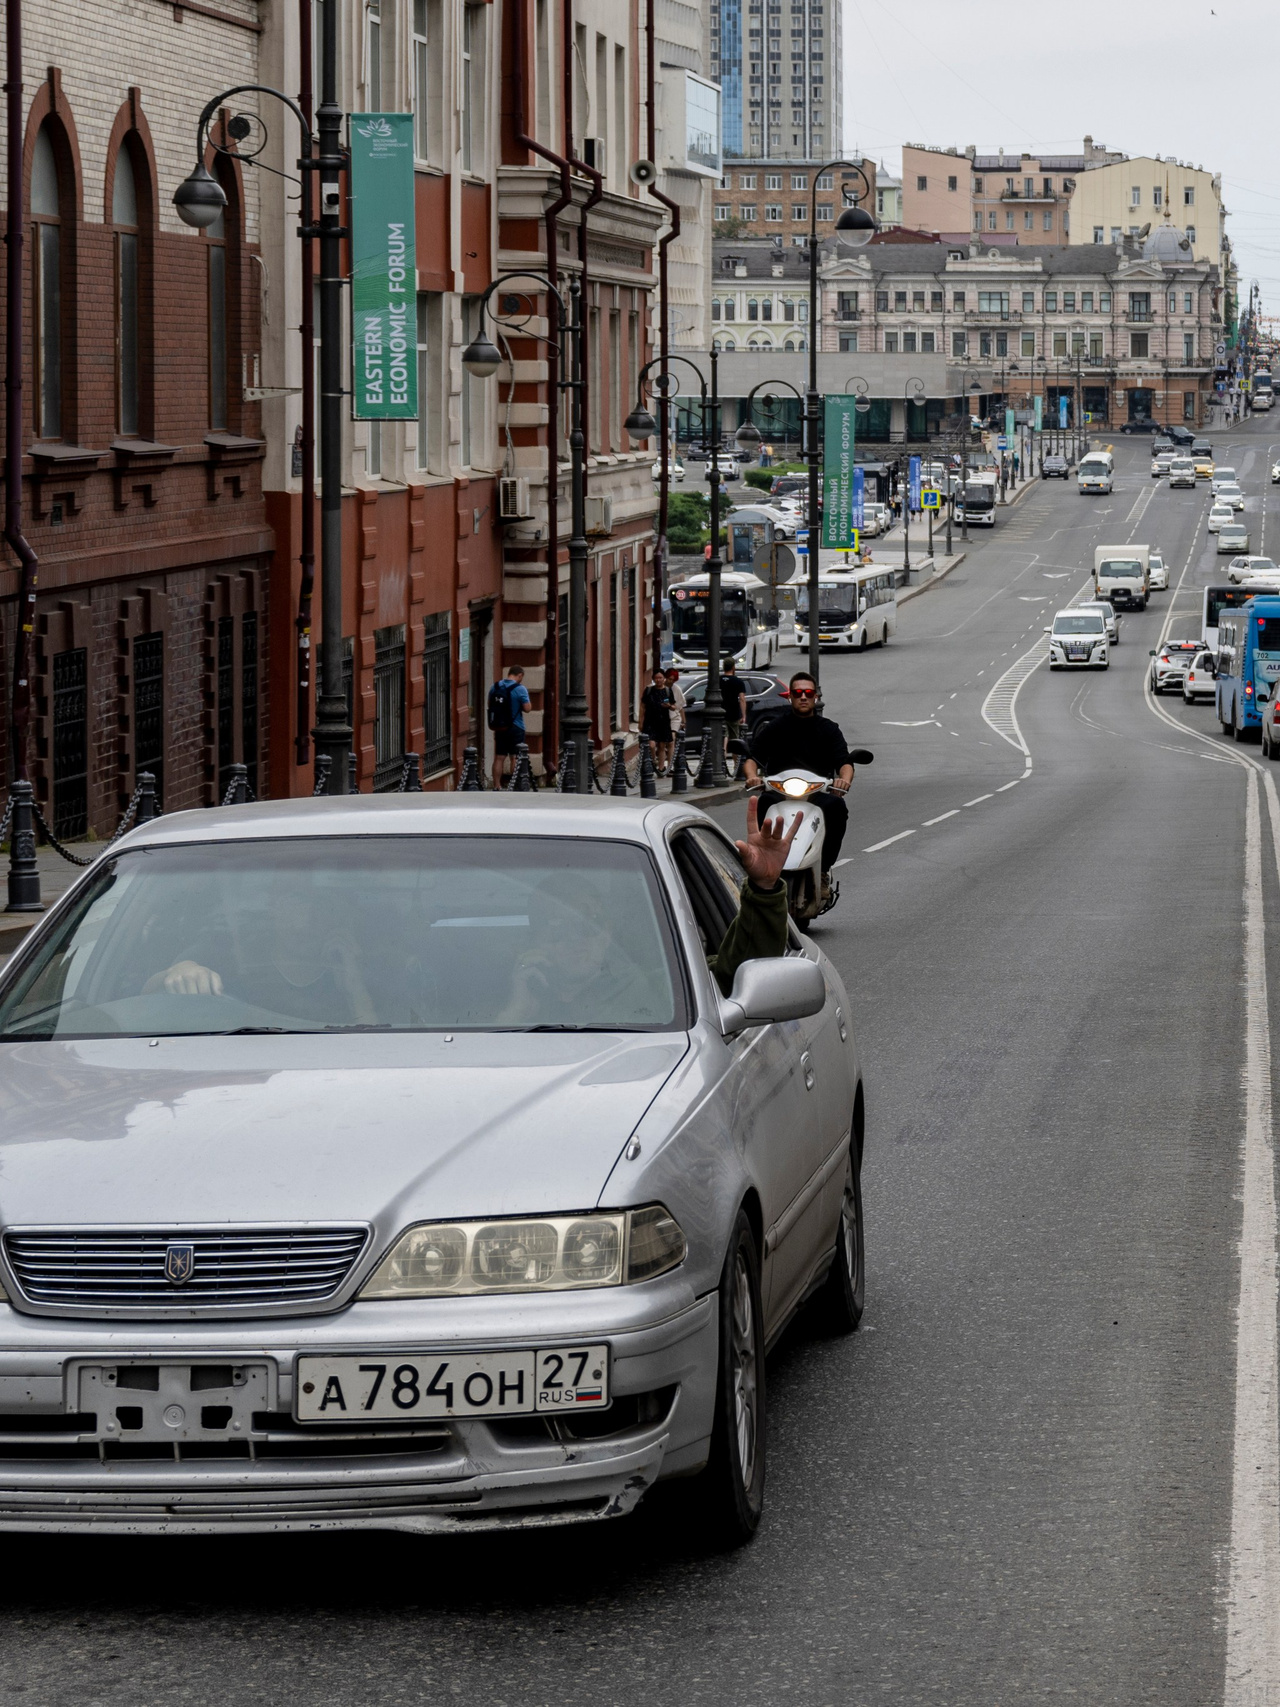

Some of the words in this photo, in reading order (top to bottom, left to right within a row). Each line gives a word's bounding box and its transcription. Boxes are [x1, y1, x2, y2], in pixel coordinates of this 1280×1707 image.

[388, 223, 406, 293] FORUM
[365, 317, 384, 404] EASTERN
[389, 302, 408, 404] ECONOMIC
[841, 412, 850, 450] ФОРУМ
[828, 478, 838, 542] ВОСТОЧНЫЙ
[839, 452, 849, 542] ЭКОНОМИЧЕСКИЙ
[539, 1389, 574, 1404] RUS
[542, 1351, 589, 1389] 27
